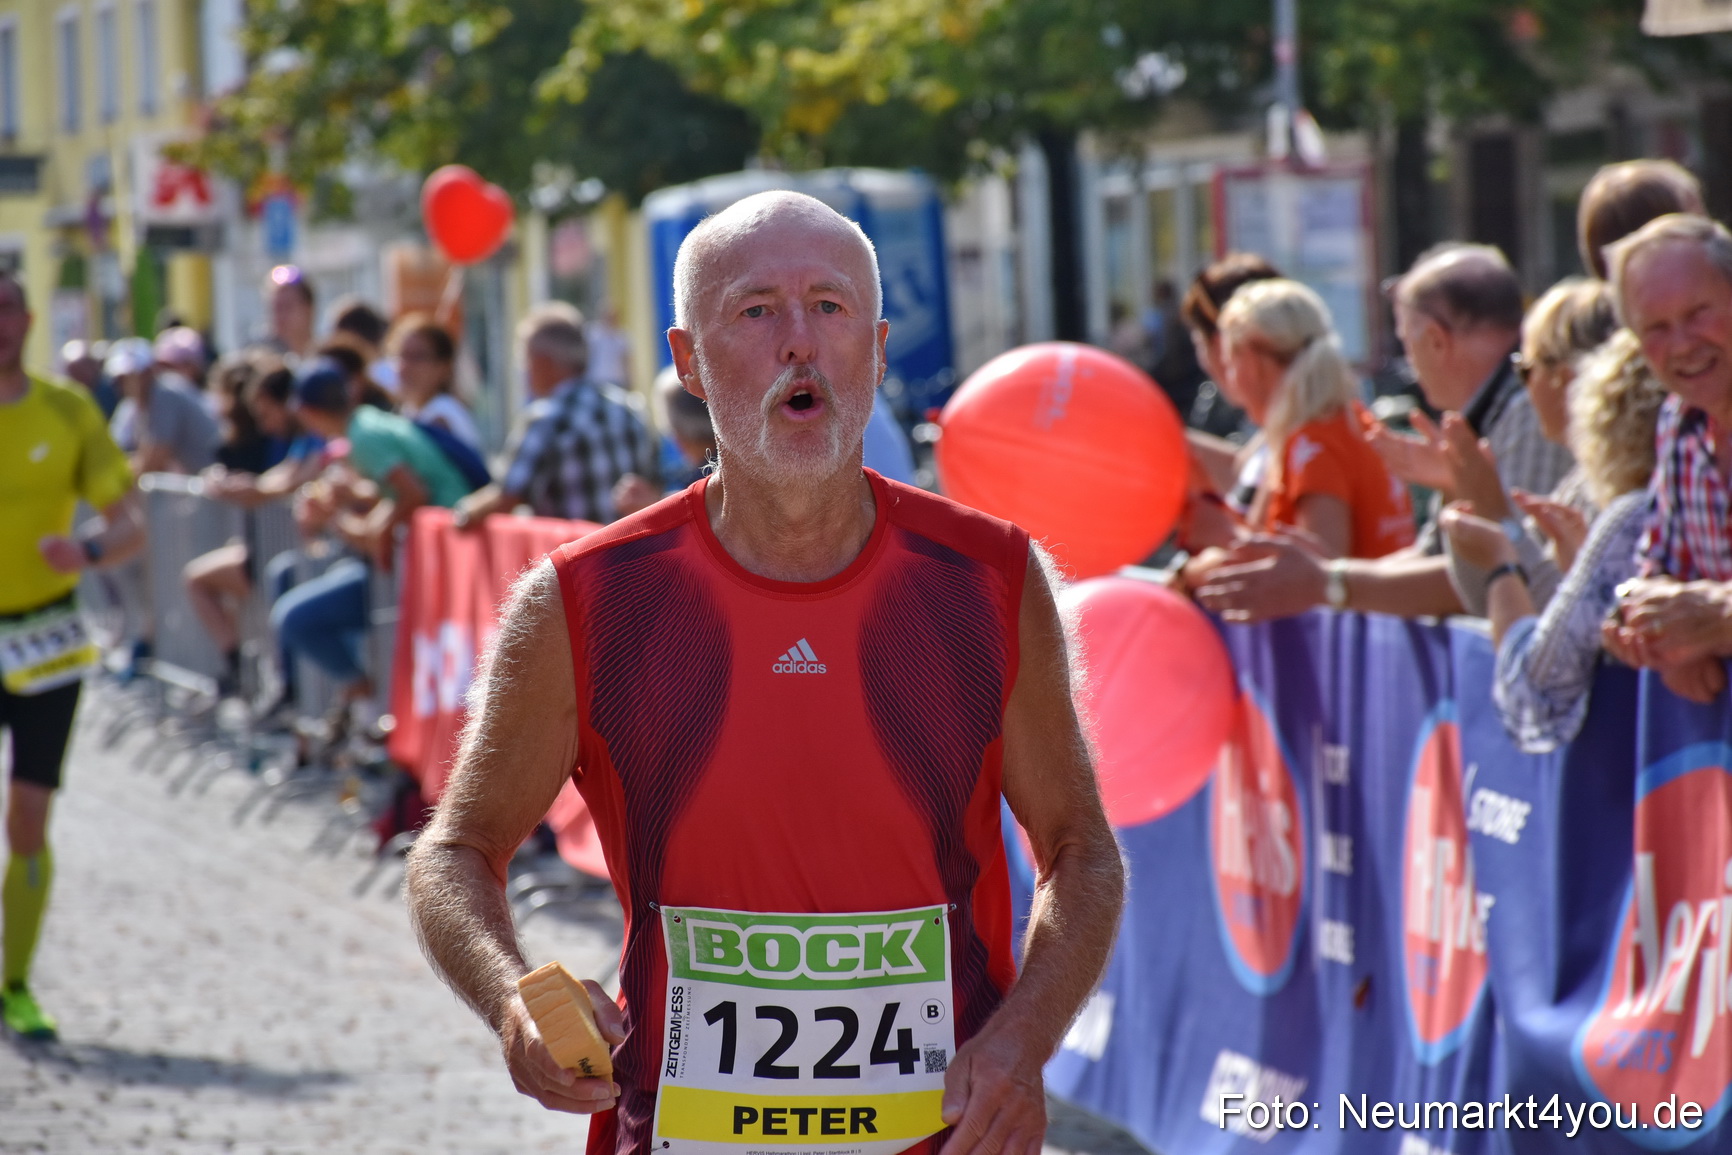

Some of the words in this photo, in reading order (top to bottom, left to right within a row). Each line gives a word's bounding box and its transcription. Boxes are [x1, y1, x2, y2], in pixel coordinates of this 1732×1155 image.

[772, 660, 827, 674] adidas
[688, 919, 922, 979] BOCK
[927, 1005, 939, 1018] B
[680, 1034, 689, 1078] TRANSPONDER
[703, 1000, 920, 1079] 1224
[733, 1105, 878, 1135] PETER
